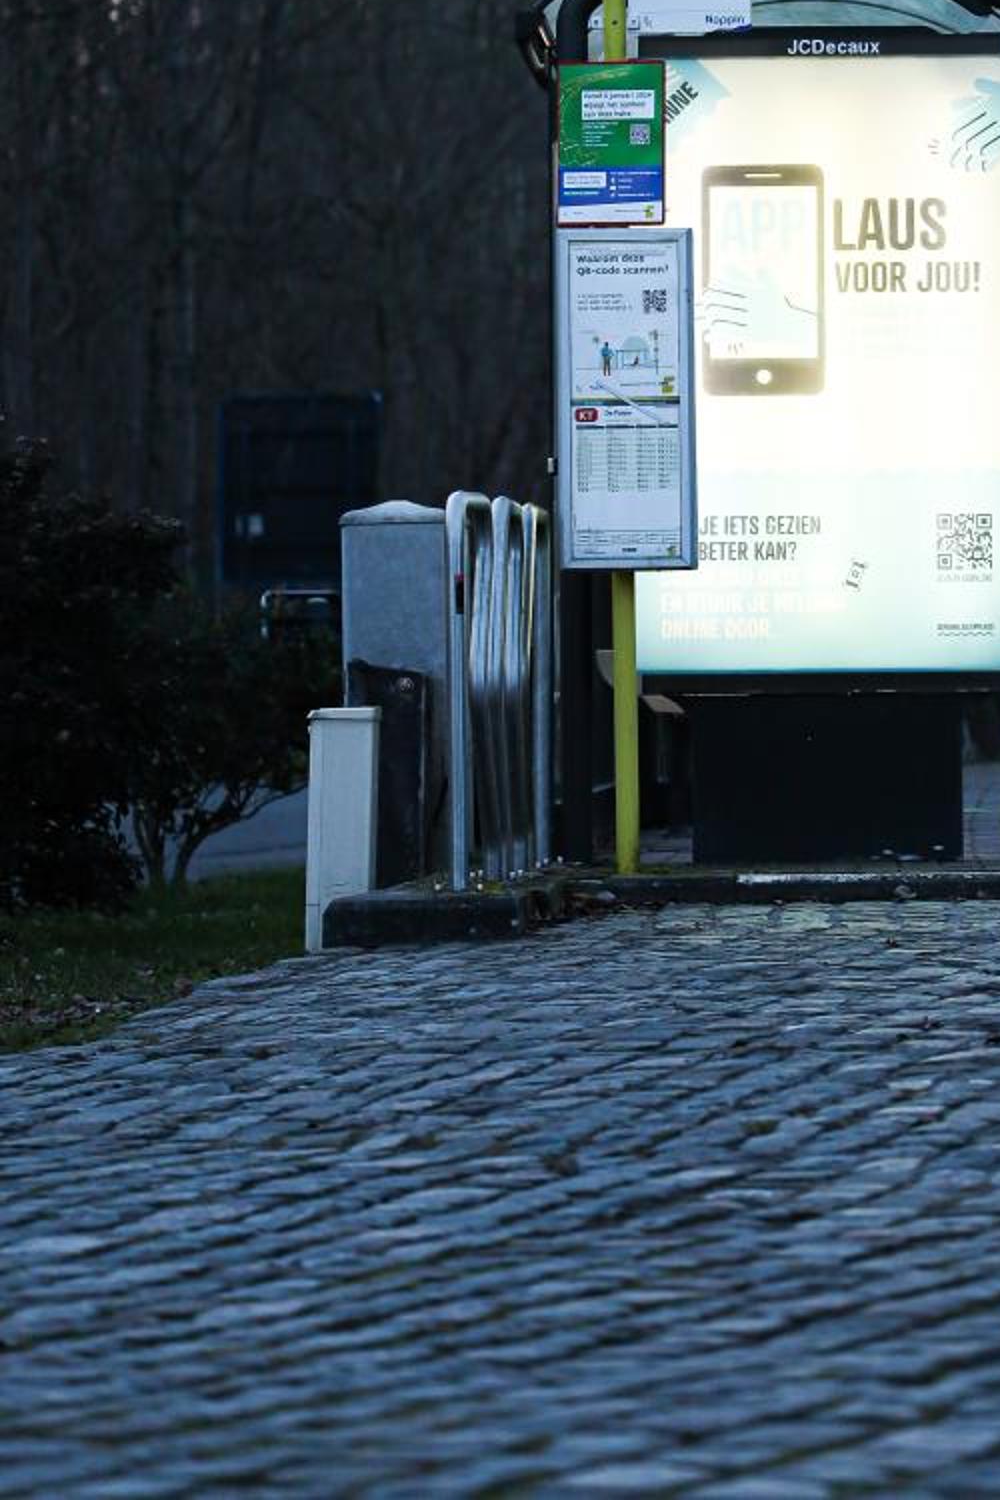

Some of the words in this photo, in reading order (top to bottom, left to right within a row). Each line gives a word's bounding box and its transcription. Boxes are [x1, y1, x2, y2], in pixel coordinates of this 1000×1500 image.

[786, 38, 881, 56] JCDecaux
[835, 261, 907, 293] VOOR
[916, 261, 981, 293] JOU!
[579, 411, 595, 421] KT
[700, 515, 719, 536] JE
[724, 515, 760, 535] IETS
[765, 515, 822, 535] GEZIEN
[699, 541, 749, 562] BETER
[754, 541, 798, 562] KAN?
